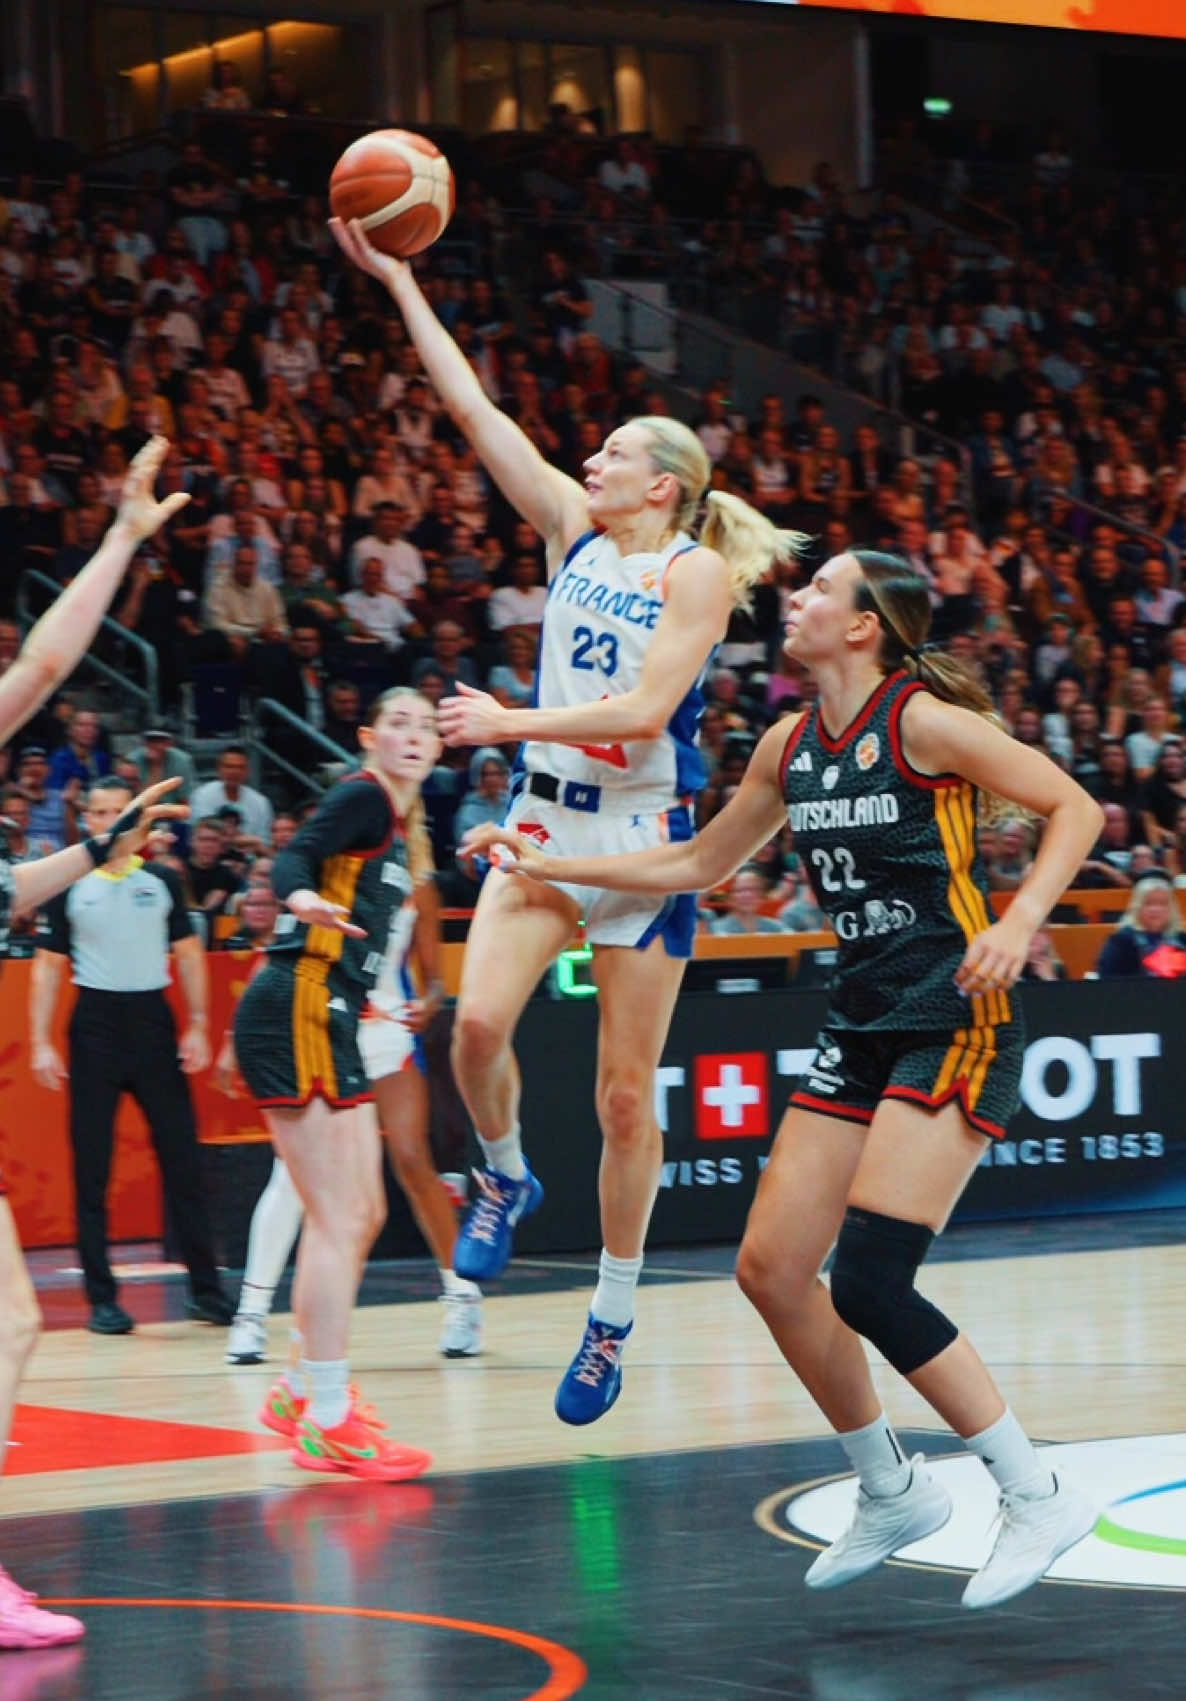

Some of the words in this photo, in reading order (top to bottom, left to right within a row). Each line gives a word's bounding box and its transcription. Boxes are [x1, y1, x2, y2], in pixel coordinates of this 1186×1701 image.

[557, 573, 663, 629] FRANCE
[571, 625, 618, 677] 23
[787, 794, 900, 831] UTSCHLAND
[811, 847, 867, 892] 22
[1080, 1132, 1164, 1161] 1853
